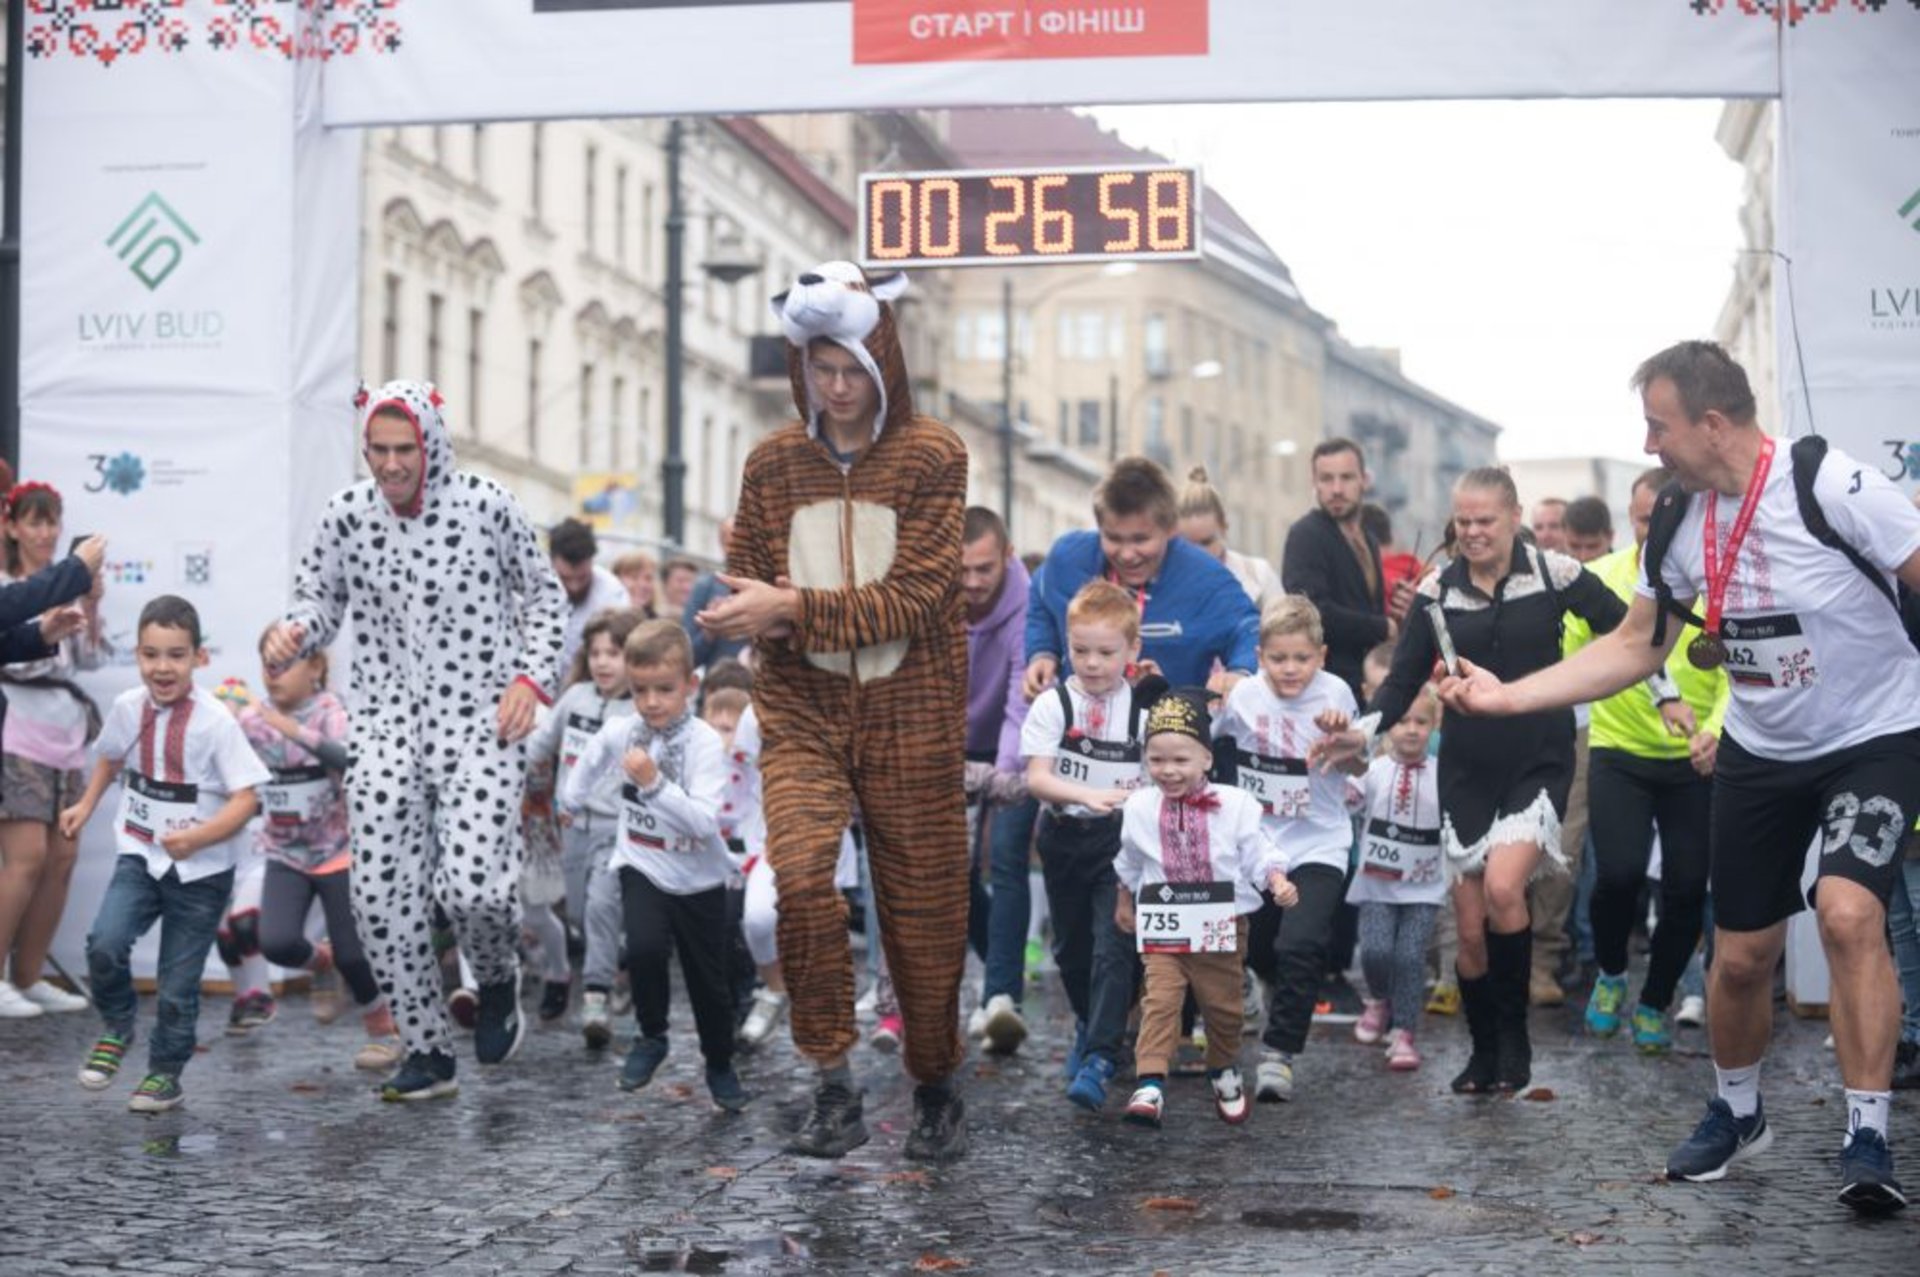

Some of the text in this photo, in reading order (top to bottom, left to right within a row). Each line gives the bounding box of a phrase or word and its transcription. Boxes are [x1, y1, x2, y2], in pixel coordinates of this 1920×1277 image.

[908, 11, 1015, 39] СТАРТ
[1039, 8, 1146, 34] ФІНІШ
[871, 171, 1189, 259] 00 26 58
[78, 310, 226, 341] LVIV BUD
[1060, 757, 1089, 782] 811
[1241, 772, 1266, 795] 792
[626, 806, 656, 831] 790
[1368, 841, 1401, 862] 706
[1142, 912, 1181, 932] 735
